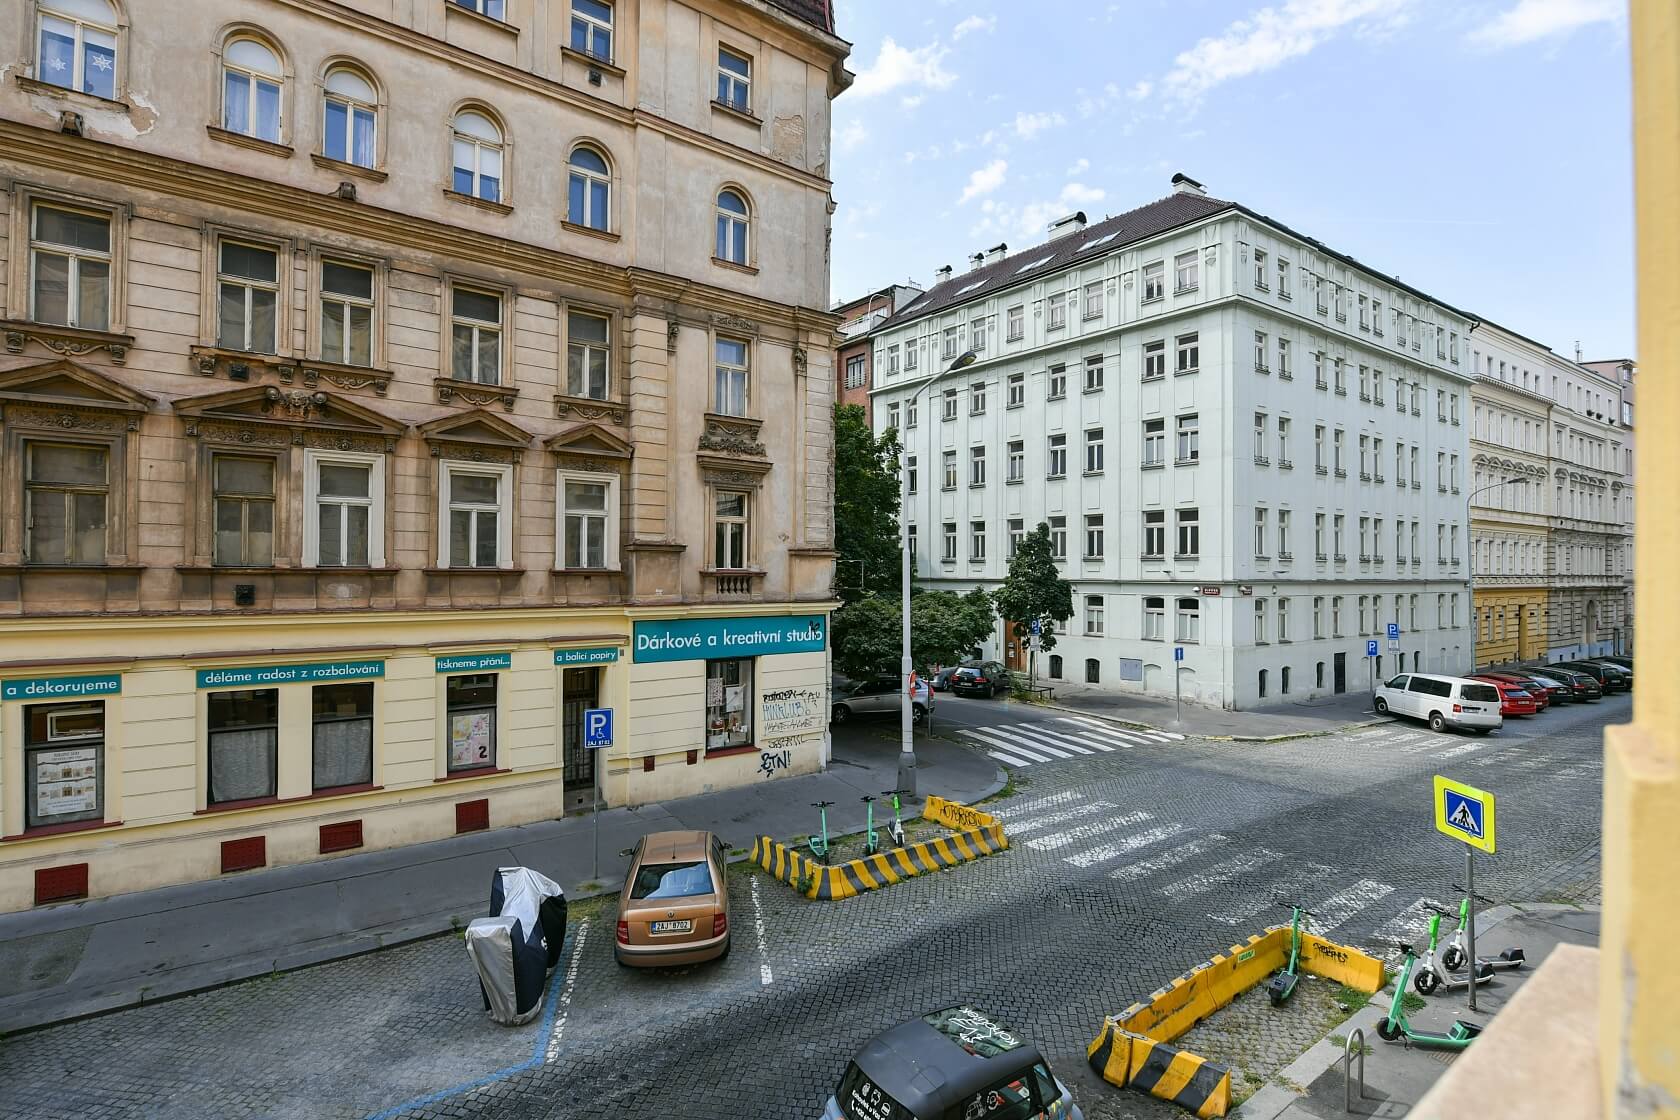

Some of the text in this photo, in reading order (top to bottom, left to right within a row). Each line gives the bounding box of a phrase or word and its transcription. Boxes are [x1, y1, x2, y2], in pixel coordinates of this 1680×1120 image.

[1389, 624, 1397, 635] P
[637, 631, 702, 651] Dárkové
[707, 635, 717, 646] a
[723, 628, 781, 646] kreativní
[786, 625, 823, 642] studio
[1368, 641, 1376, 652] P
[437, 659, 478, 669] tiskneme
[205, 664, 380, 684] děláme radost z rozbalování
[6, 681, 117, 696] a dekorujeme
[590, 714, 607, 736] P
[478, 745, 489, 759] 2
[656, 922, 669, 930] 2AJ
